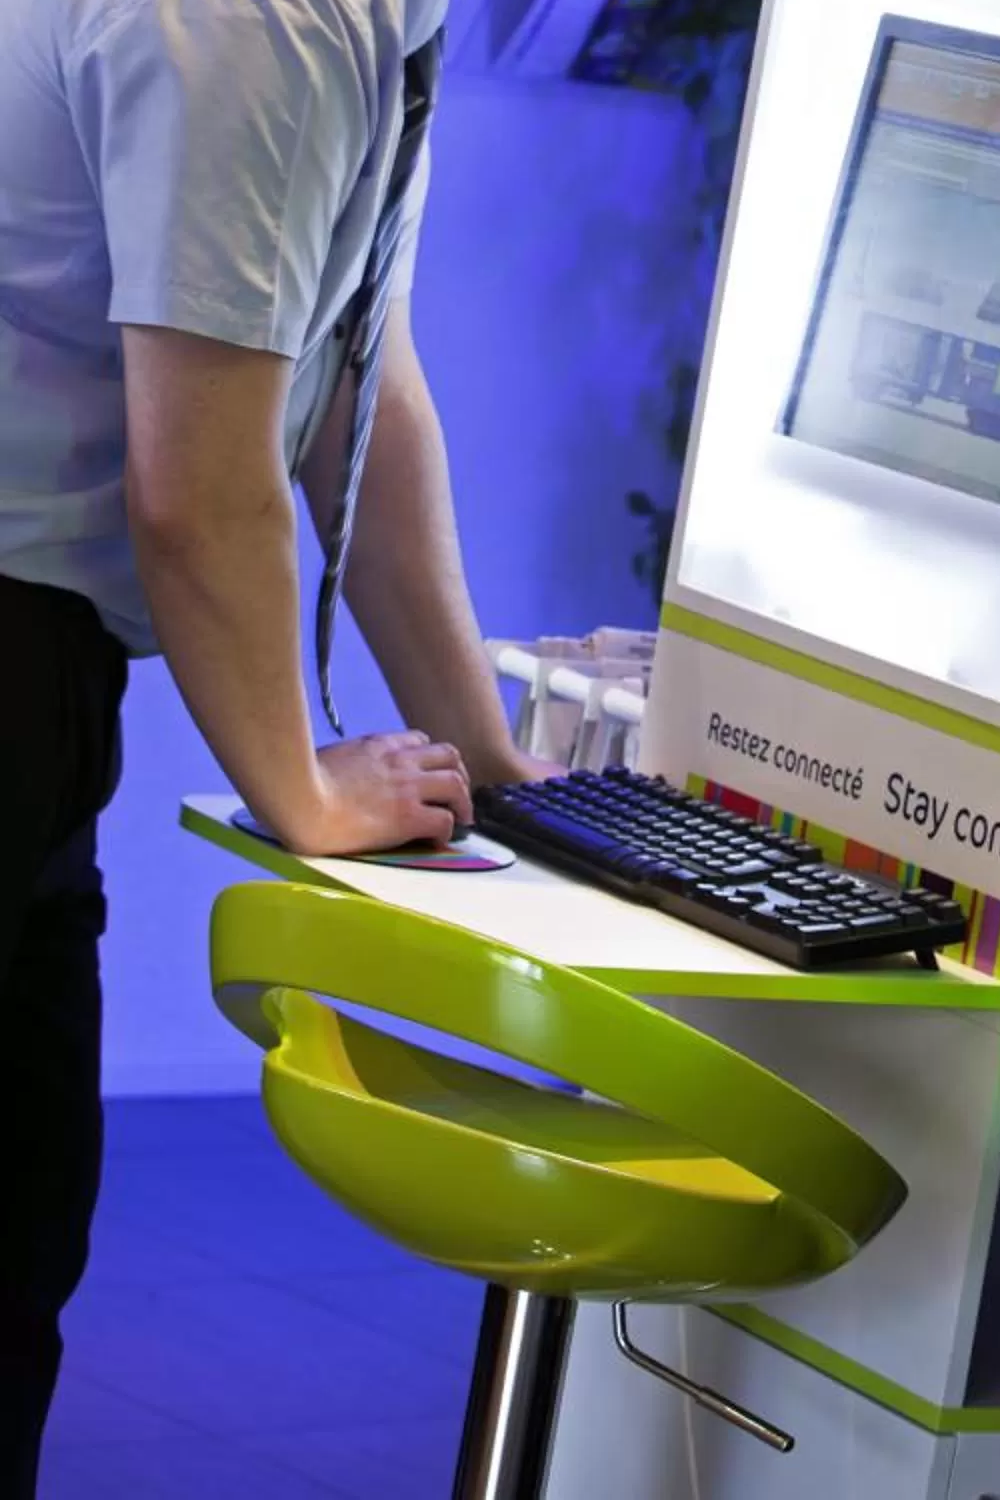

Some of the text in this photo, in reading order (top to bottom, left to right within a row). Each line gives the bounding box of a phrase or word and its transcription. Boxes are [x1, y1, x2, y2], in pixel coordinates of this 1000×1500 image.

[707, 712, 770, 763] Restez
[773, 748, 864, 800] connecté
[883, 772, 949, 840] Stay
